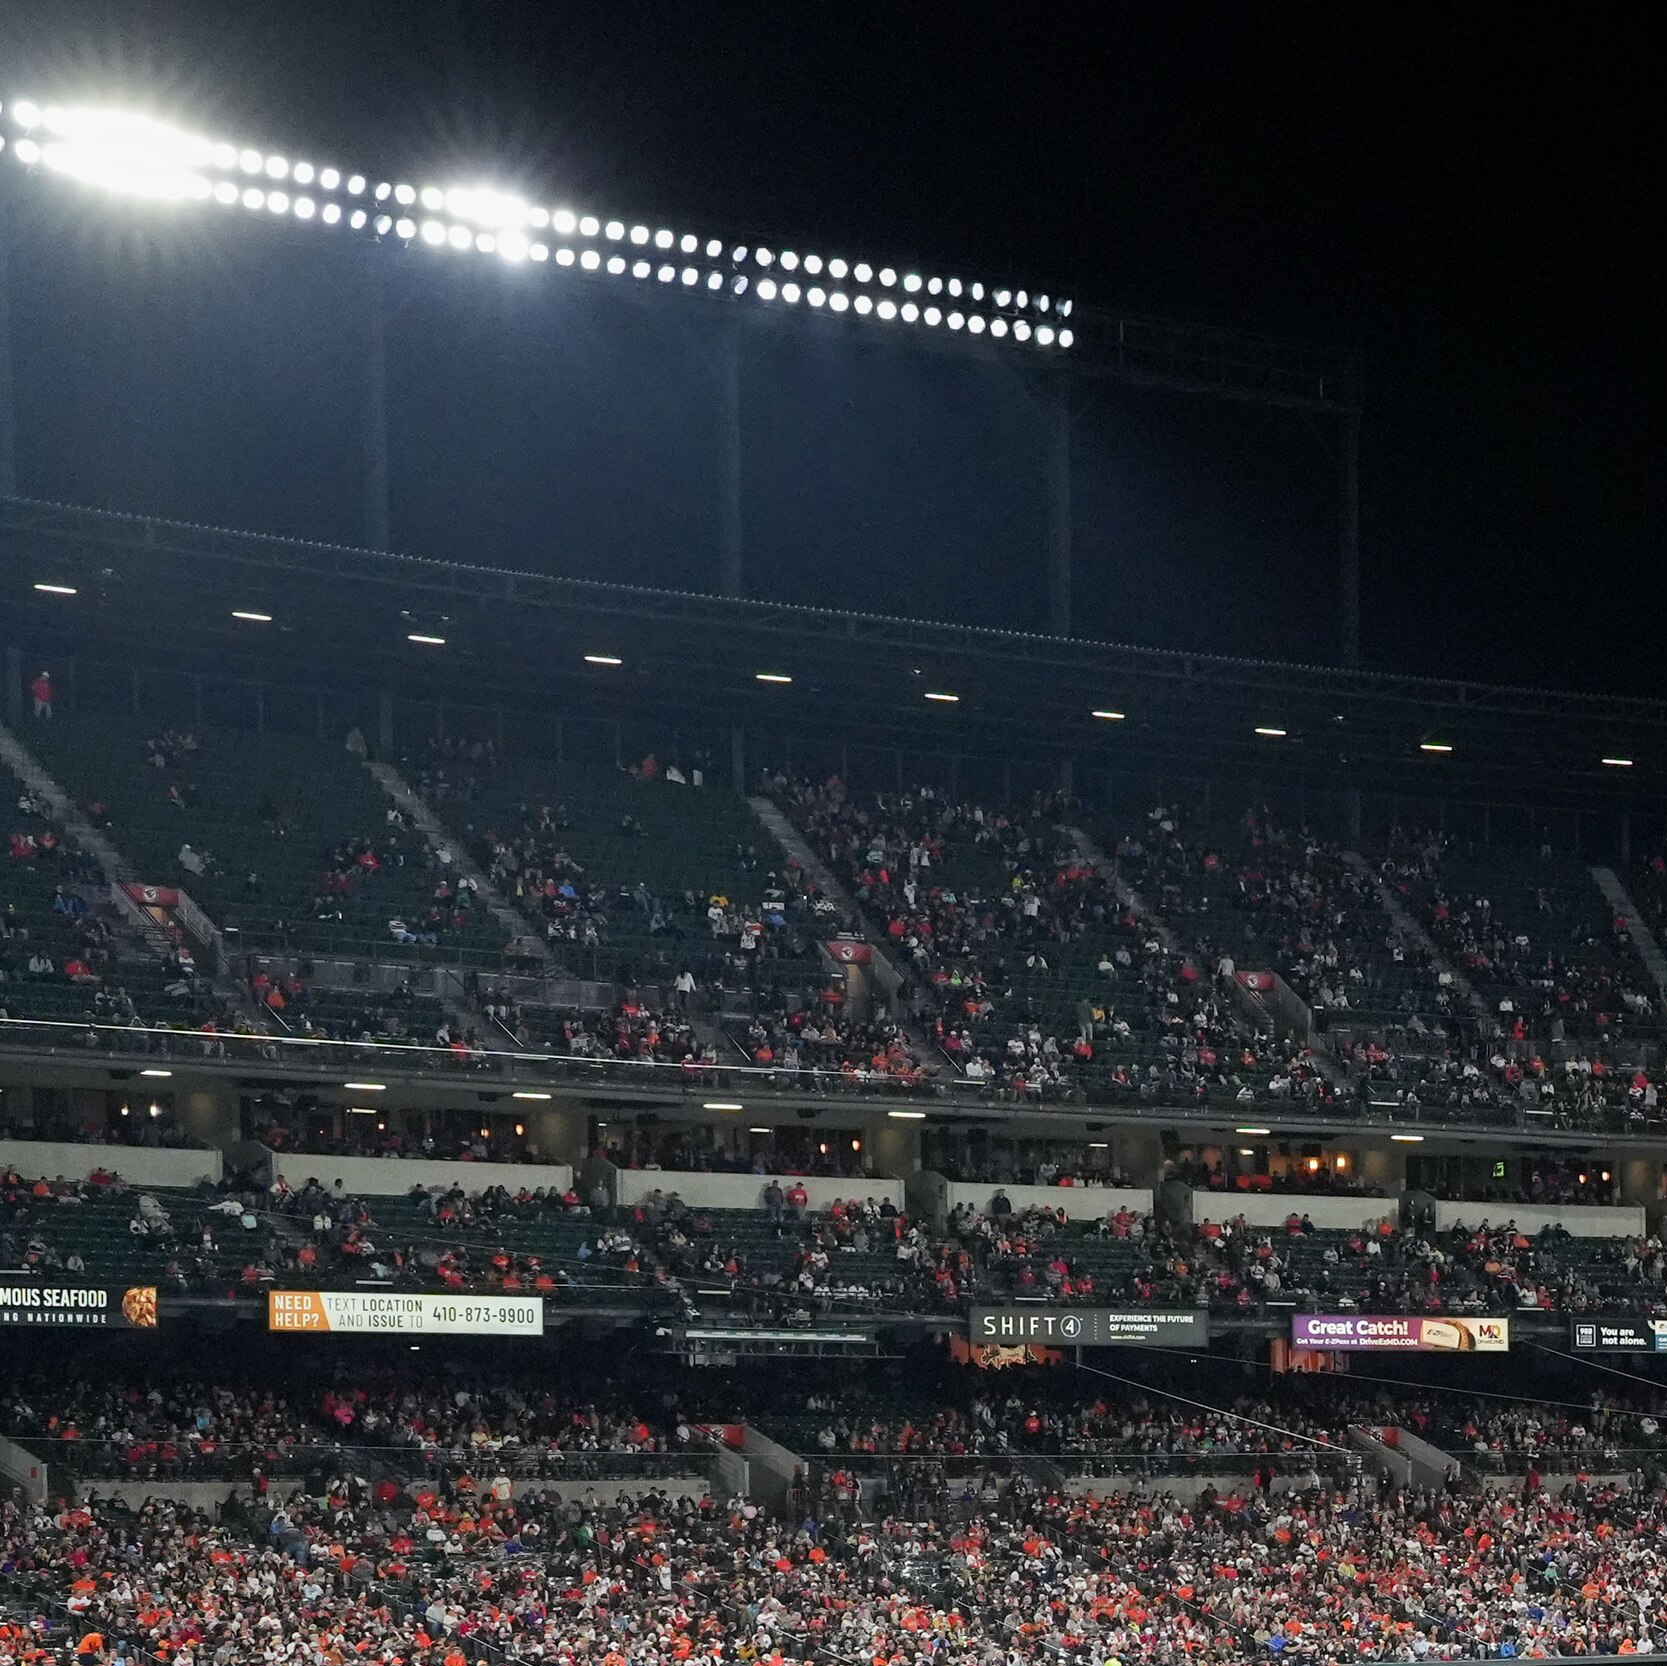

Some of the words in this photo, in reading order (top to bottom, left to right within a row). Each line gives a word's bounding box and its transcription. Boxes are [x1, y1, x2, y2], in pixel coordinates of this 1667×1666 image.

[43, 1288, 107, 1308] SEAFOOD
[274, 1295, 312, 1310] NEED
[327, 1297, 357, 1311] TEXT
[362, 1299, 423, 1313] LOCATION
[27, 1313, 107, 1324] NATIONWIDE
[274, 1312, 320, 1328] HELP?
[338, 1314, 363, 1327] AND
[368, 1314, 403, 1328] ISSUE
[410, 1314, 423, 1328] TO
[432, 1306, 535, 1324] 410-873-9900
[1109, 1314, 1152, 1322] EXPERIENCE
[1153, 1315, 1166, 1323] THE
[1167, 1315, 1194, 1323] FUTURE
[983, 1315, 1057, 1336] SHIFT
[1109, 1323, 1119, 1332] OF
[1120, 1323, 1158, 1332] PAYMENTS
[1308, 1320, 1354, 1336] Great
[1356, 1320, 1409, 1336] Catch!
[1600, 1327, 1618, 1337] You
[1619, 1328, 1635, 1337] are
[1296, 1337, 1308, 1345] Get
[1309, 1337, 1324, 1345] Your
[1602, 1336, 1618, 1346] not
[1619, 1336, 1647, 1346] alone.
